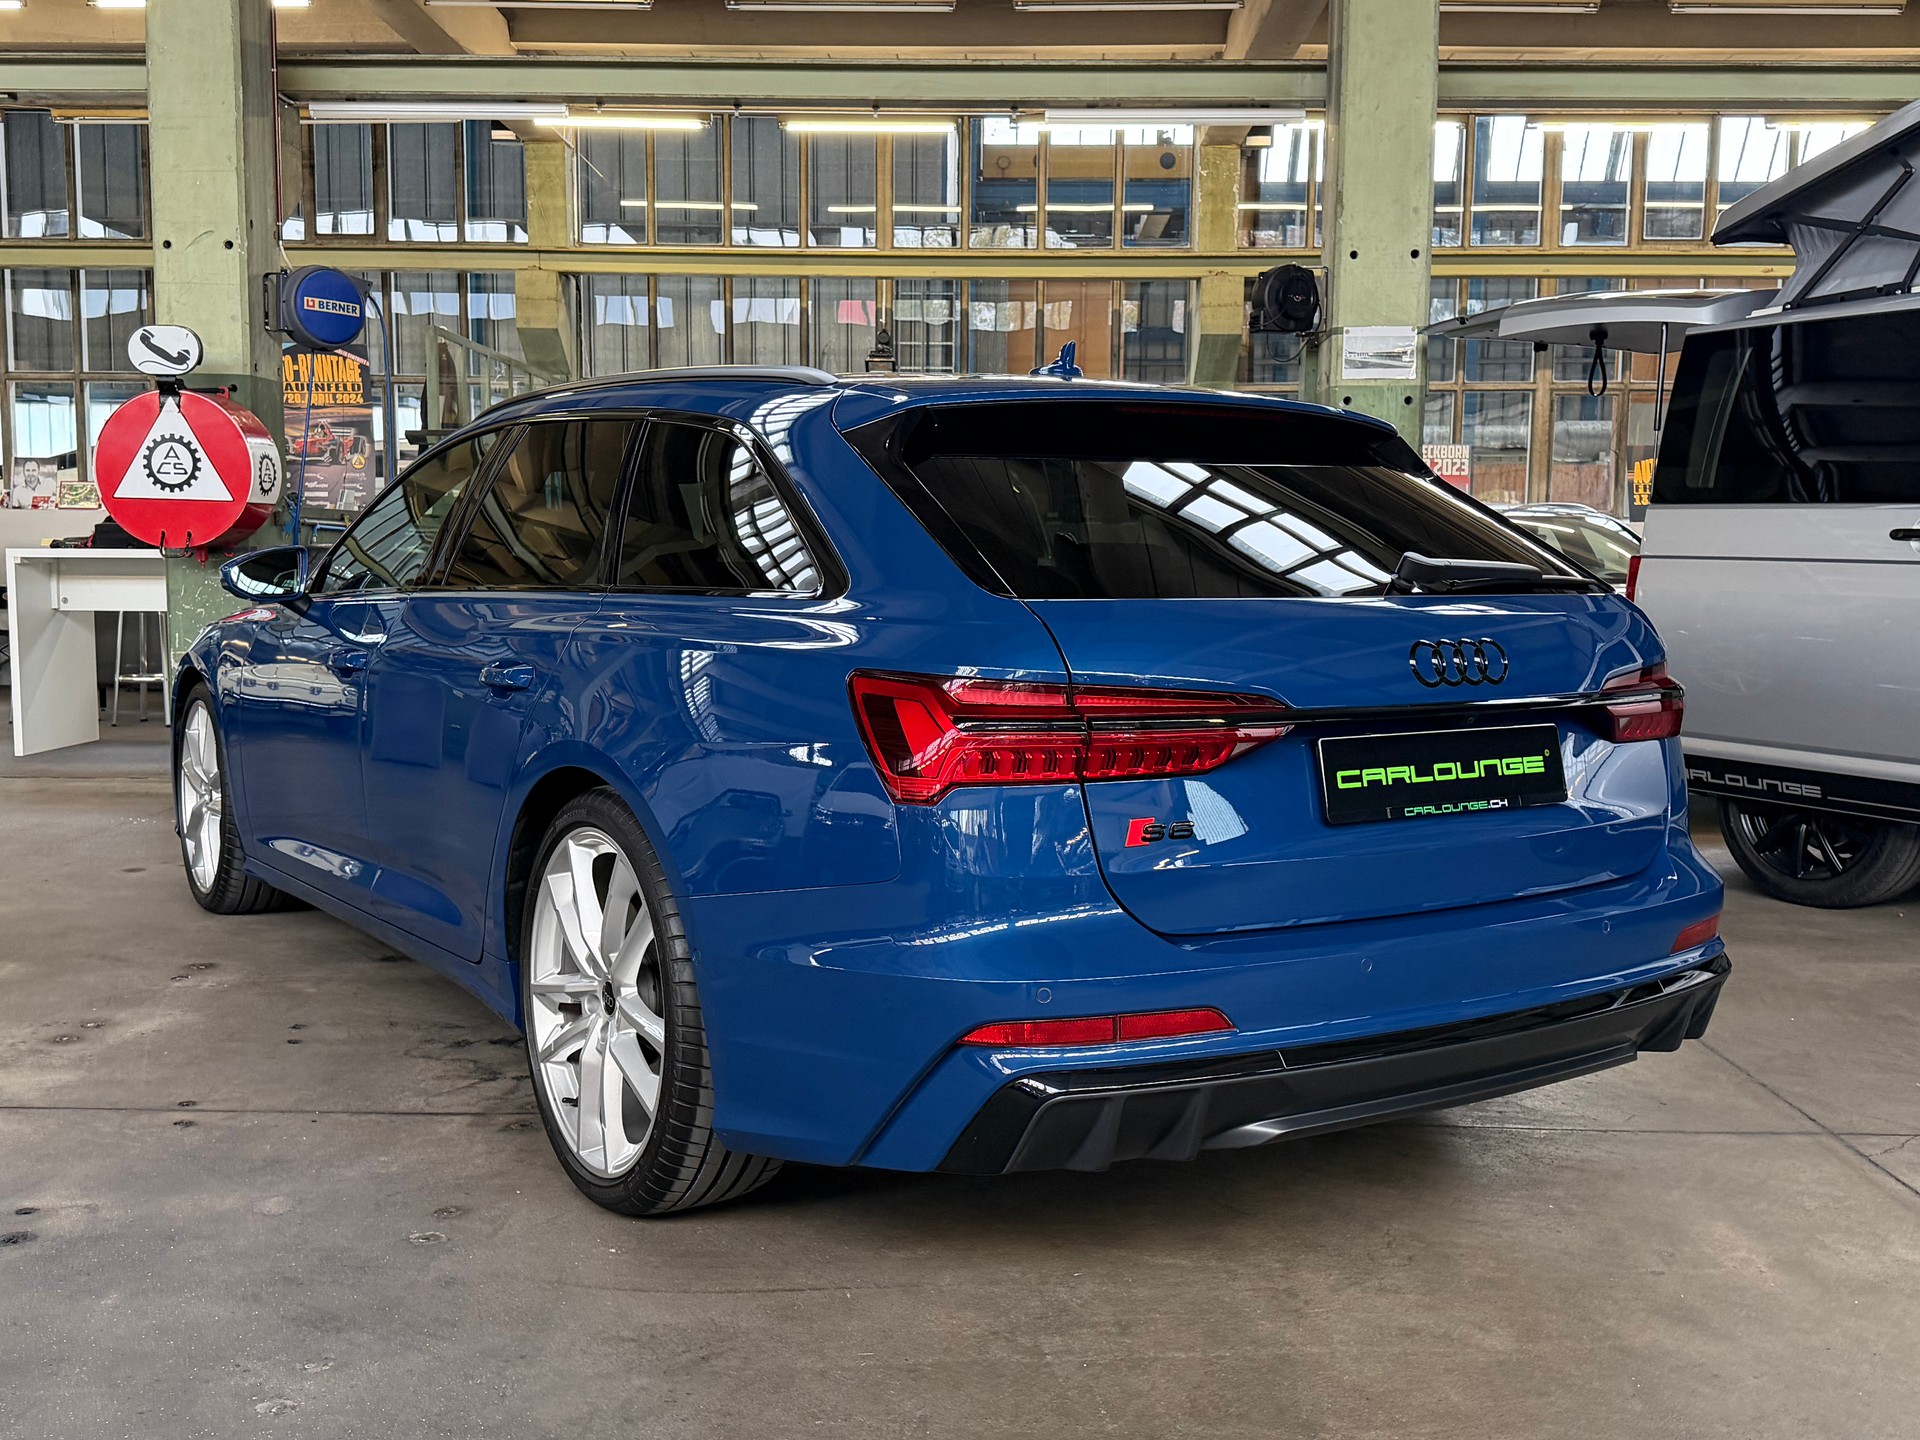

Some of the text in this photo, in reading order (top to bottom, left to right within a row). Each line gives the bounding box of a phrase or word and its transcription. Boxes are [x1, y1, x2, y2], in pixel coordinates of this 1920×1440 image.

[318, 300, 358, 315] BERNER
[283, 353, 362, 382] O-RNNTAGE
[336, 393, 364, 404] 2024
[1336, 755, 1545, 789] CARLOUNGE
[1685, 768, 1822, 798] RLOUNGE
[1404, 798, 1509, 817] CARLOUNGE.CH
[1139, 820, 1195, 843] S6
